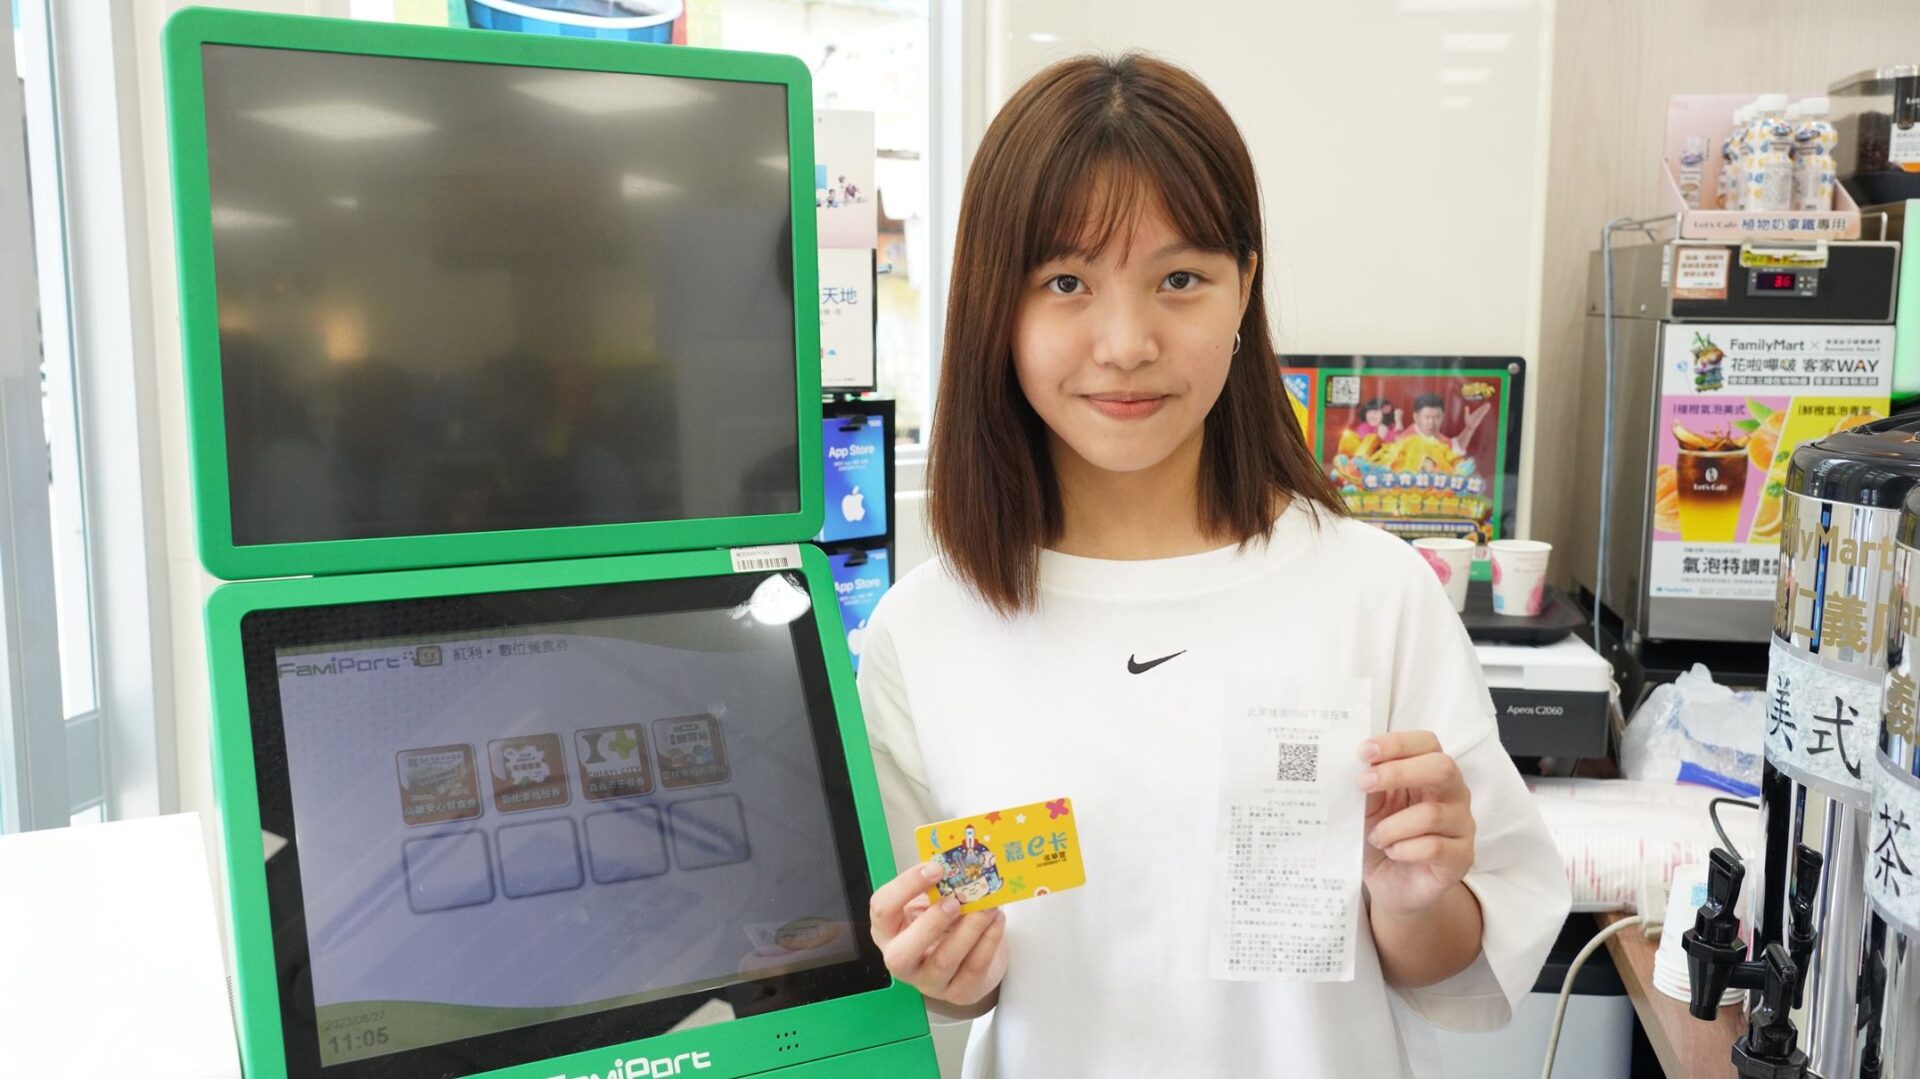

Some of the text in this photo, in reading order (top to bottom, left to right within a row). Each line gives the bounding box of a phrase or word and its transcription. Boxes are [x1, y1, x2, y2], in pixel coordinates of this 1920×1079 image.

[1742, 219, 1846, 231] 植物奶拿鐵專用
[1730, 339, 1804, 353] FamilyMart
[1803, 358, 1879, 373] 客家WAY
[828, 444, 875, 459] App Store
[1682, 556, 1761, 576] 氣泡特調
[855, 578, 881, 590] Store
[1507, 705, 1564, 716] Apeos C2060
[1766, 673, 1862, 780] 美式
[1874, 802, 1914, 897] 茶
[326, 1010, 385, 1031] 2023/06/27
[328, 1026, 389, 1054] 11:05
